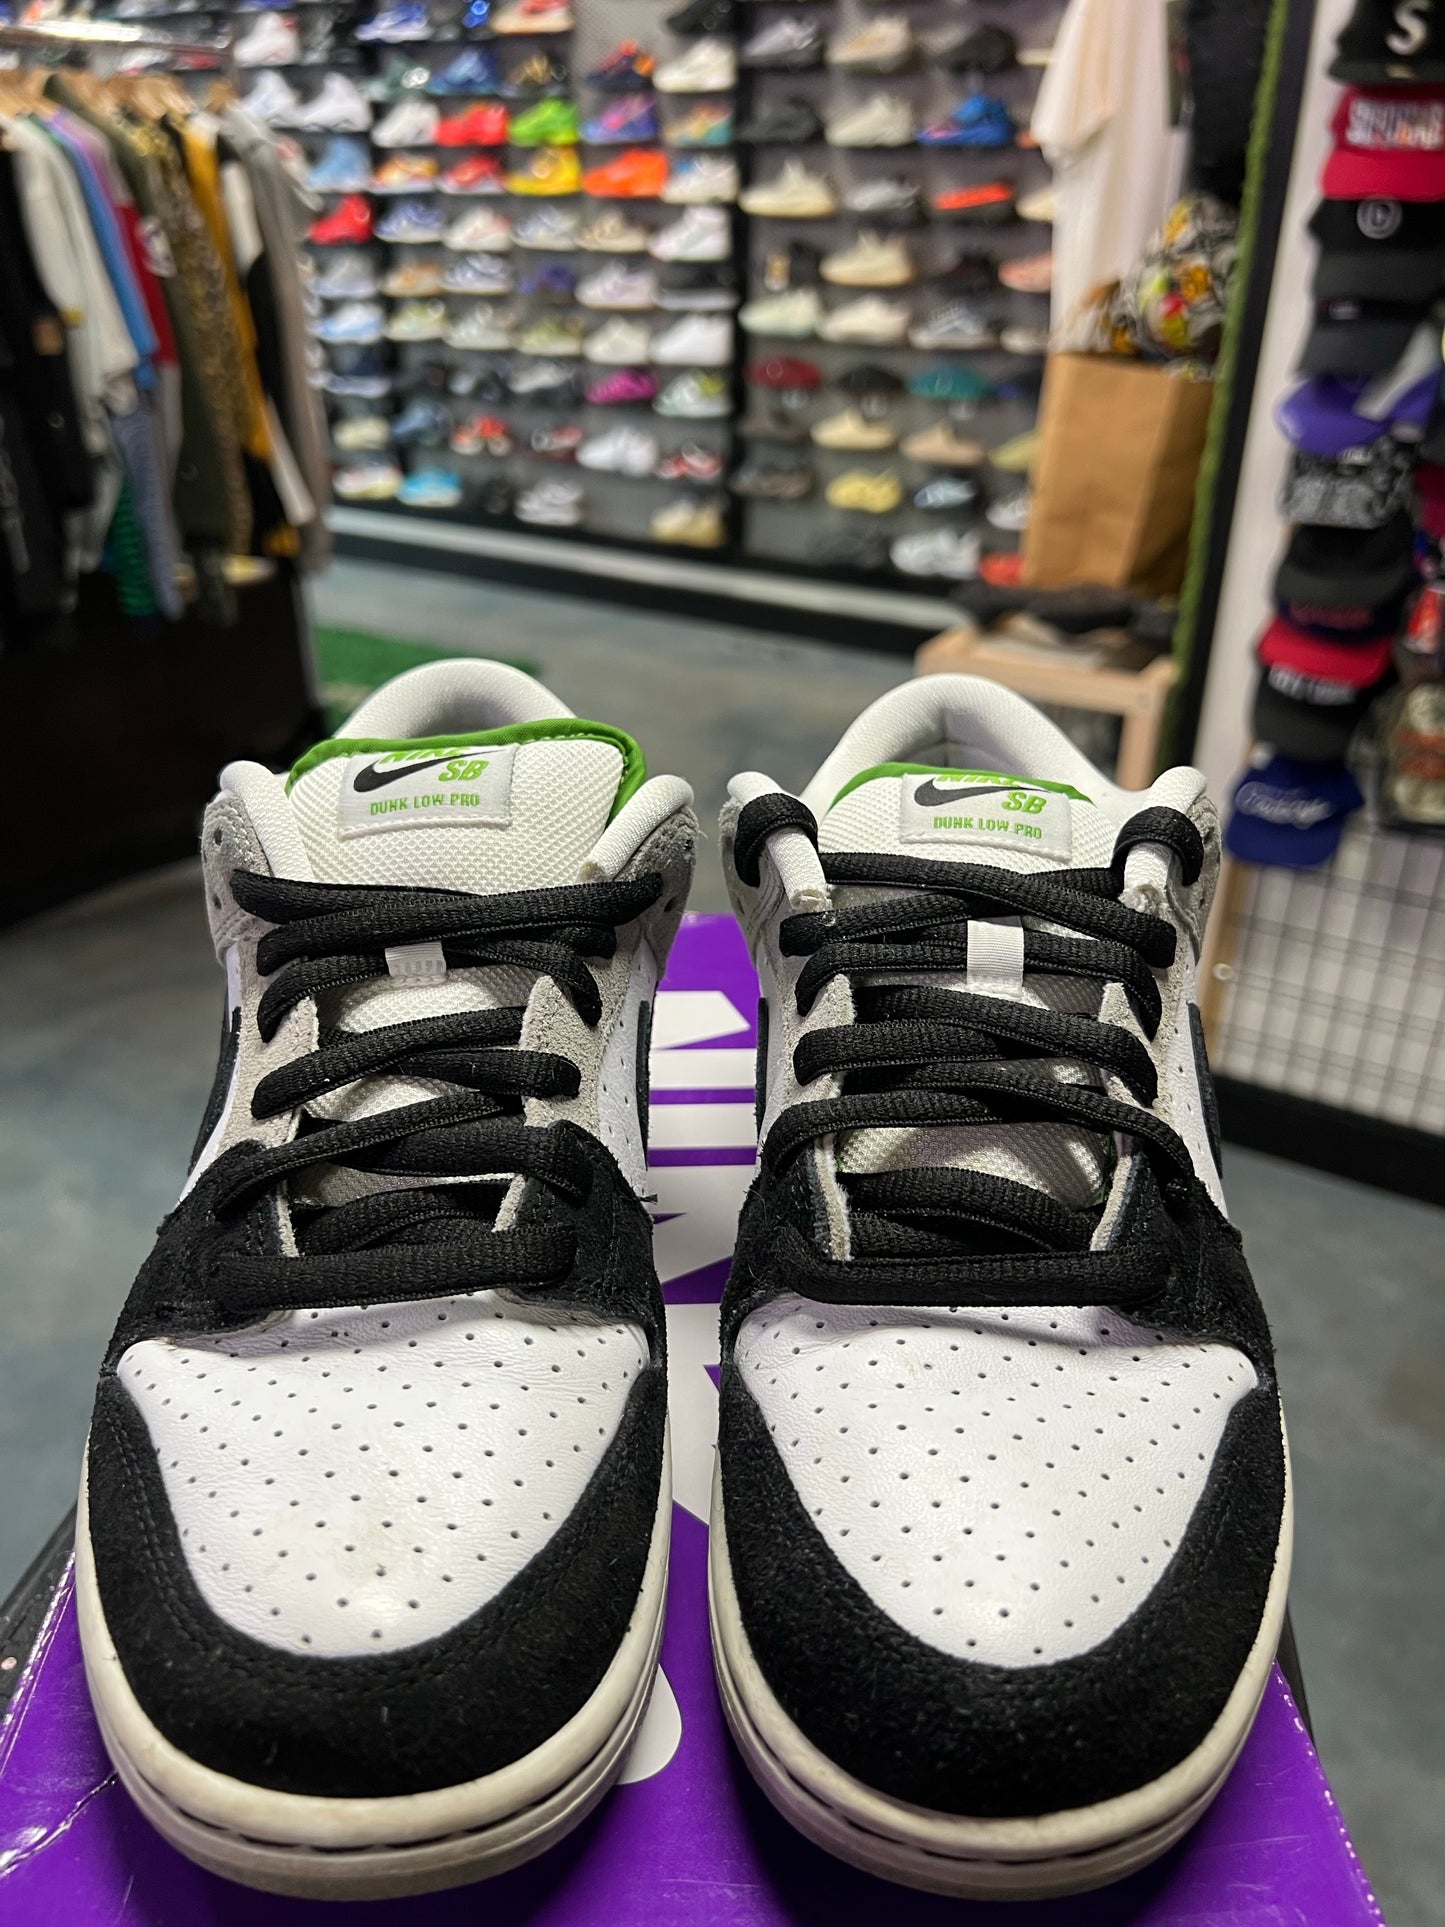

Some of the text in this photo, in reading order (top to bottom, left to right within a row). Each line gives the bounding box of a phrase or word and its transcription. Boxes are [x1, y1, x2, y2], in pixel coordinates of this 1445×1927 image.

[1384, 0, 1430, 55] S
[438, 759, 490, 782] SB
[369, 792, 481, 816] DUNK LOW PRO
[1001, 791, 1048, 815] SB
[933, 816, 1043, 839] DUNK LOW PRO
